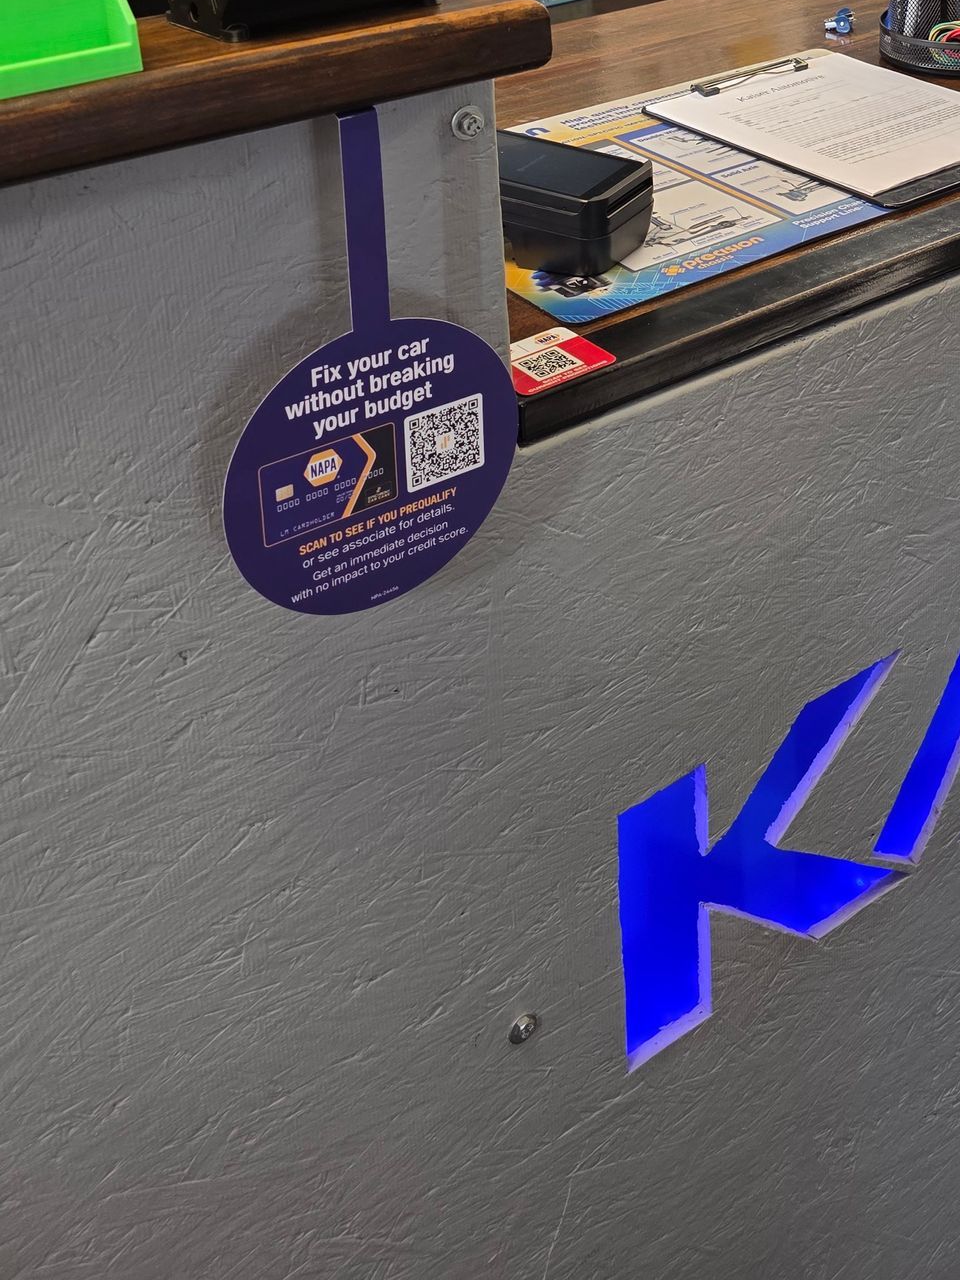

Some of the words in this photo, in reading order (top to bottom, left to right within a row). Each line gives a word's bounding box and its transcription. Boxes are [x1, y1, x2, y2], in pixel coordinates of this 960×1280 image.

[736, 87, 770, 103] Kaiser
[770, 74, 825, 94] Automotive
[592, 105, 629, 119] quality
[792, 208, 838, 226] Precision
[800, 213, 840, 229] Support
[698, 254, 735, 269] chassis
[537, 334, 557, 344] NAPA
[310, 365, 342, 388] Fix
[347, 347, 392, 380] your
[397, 337, 430, 361] car
[285, 378, 365, 420] without
[369, 353, 455, 394] breaking
[313, 406, 360, 440] your
[364, 381, 433, 419] budget
[310, 457, 337, 479] NAPA
[298, 536, 328, 557] SCAN
[329, 531, 343, 544] TO
[345, 522, 364, 537] SEE
[366, 517, 376, 530] IF
[378, 510, 397, 524] YOU
[399, 486, 458, 518] PREQUALIFY
[302, 556, 315, 570] or
[317, 547, 340, 563] see
[342, 525, 397, 554] associate
[398, 516, 415, 532] for
[417, 503, 456, 526] details.
[290, 587, 314, 605] with
[315, 580, 330, 593] no
[331, 566, 368, 591] impact
[370, 559, 381, 572] to
[382, 549, 406, 570] your
[407, 536, 437, 557] credit
[438, 527, 469, 547] score.
[312, 567, 333, 582] Get
[334, 560, 348, 573] an
[350, 538, 405, 568] immediate
[407, 521, 449, 547] decision
